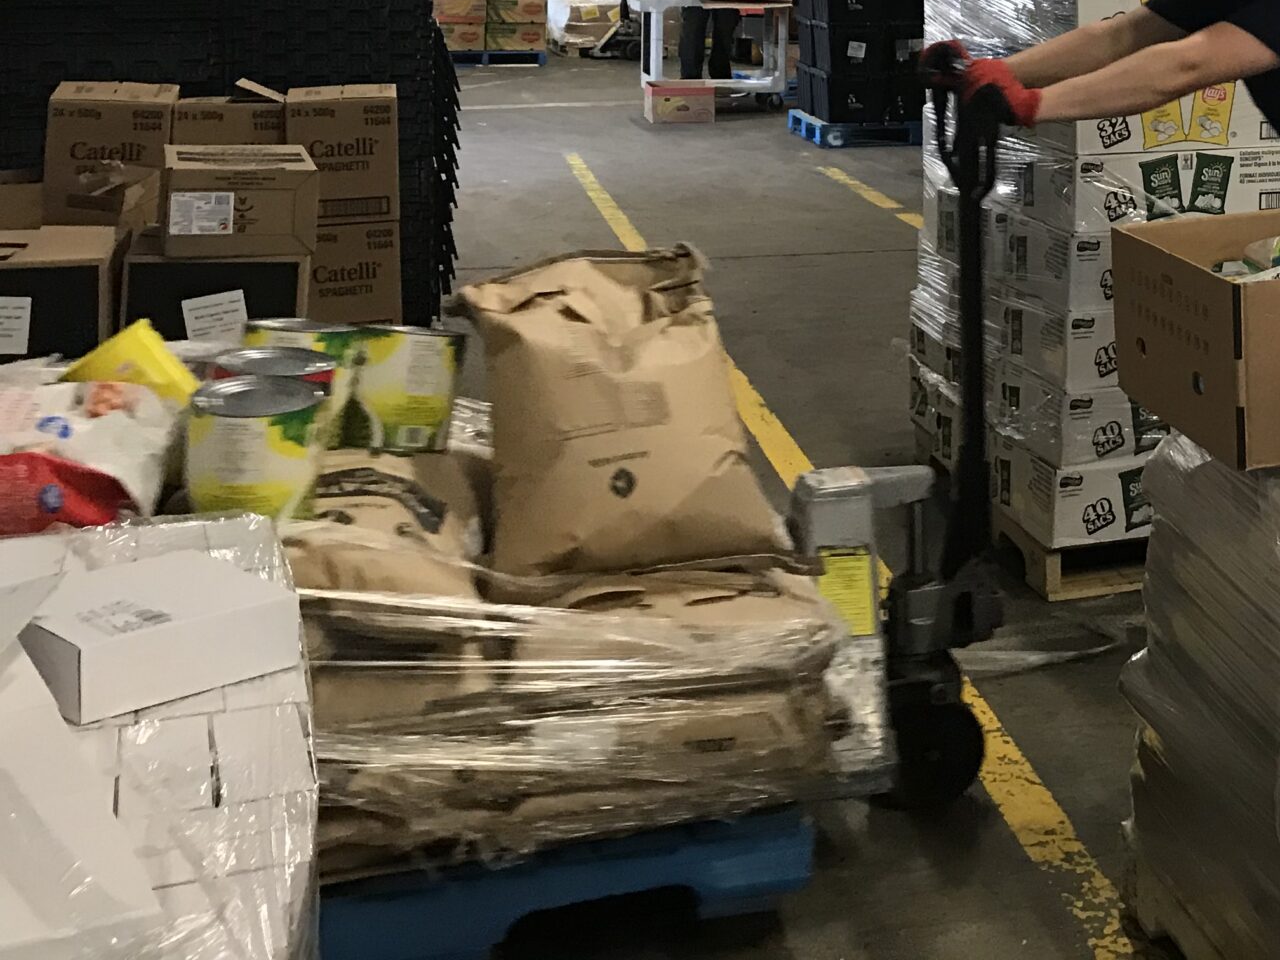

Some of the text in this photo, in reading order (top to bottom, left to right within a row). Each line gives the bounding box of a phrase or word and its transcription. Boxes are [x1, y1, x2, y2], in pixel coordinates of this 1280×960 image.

[1098, 115, 1127, 137] 32
[310, 138, 377, 158] Catelli
[1102, 128, 1131, 148] SACS
[70, 142, 144, 161] Catelli
[313, 262, 379, 284] Catelli
[318, 285, 373, 297] SPAGHETTI
[1098, 360, 1118, 378] SAC
[1092, 420, 1122, 446] 40
[1096, 434, 1125, 457] SACS
[1082, 497, 1112, 524] 40
[1086, 512, 1116, 535] SACS
